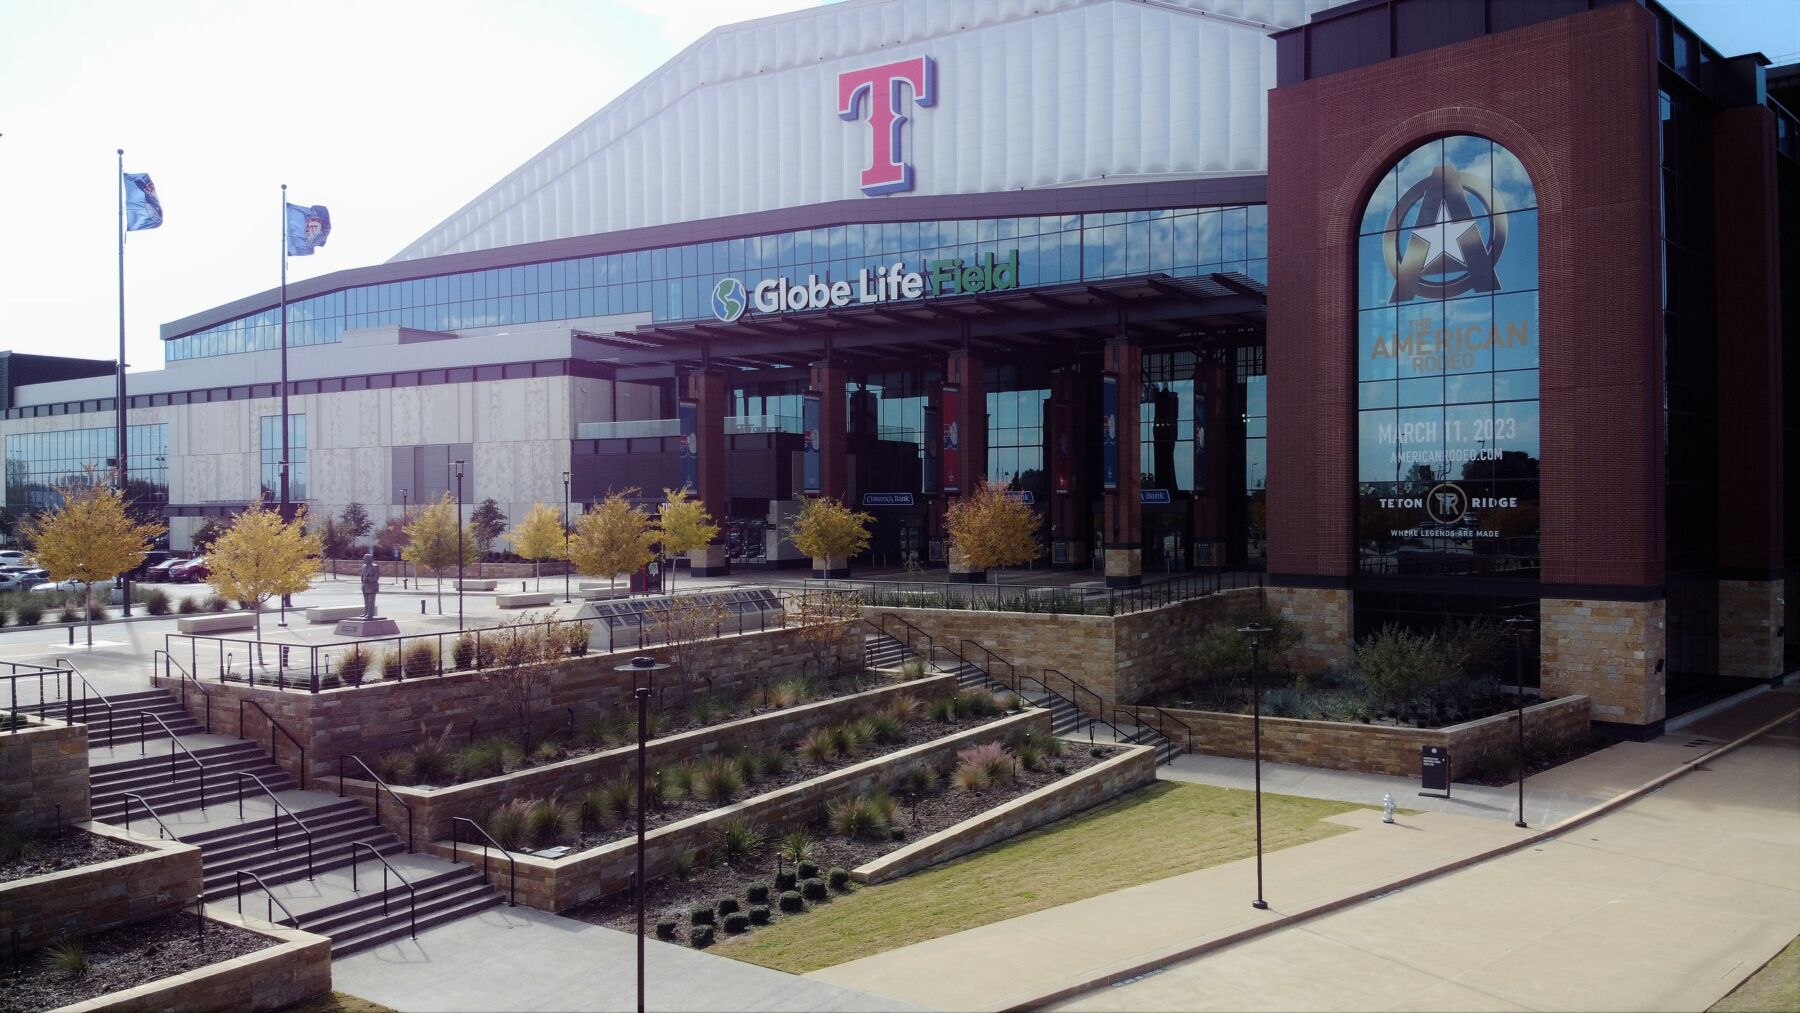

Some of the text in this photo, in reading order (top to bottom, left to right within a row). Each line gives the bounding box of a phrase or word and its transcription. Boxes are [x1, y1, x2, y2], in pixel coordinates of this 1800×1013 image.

[837, 53, 937, 198] T
[754, 248, 1020, 313] Globe Life Field
[1409, 317, 1433, 336] THE
[1370, 319, 1529, 361] AMERICAN
[1412, 352, 1475, 373] RODEO
[1378, 417, 1517, 445] MARCH 11, 2023
[1390, 447, 1503, 464] AMERICANRODEO.COM
[1145, 491, 1166, 500] Bank
[1379, 498, 1423, 509] TETON
[1471, 497, 1518, 508] RIDGE
[1390, 529, 1500, 538] WHERE LEGENDS ARE MADE
